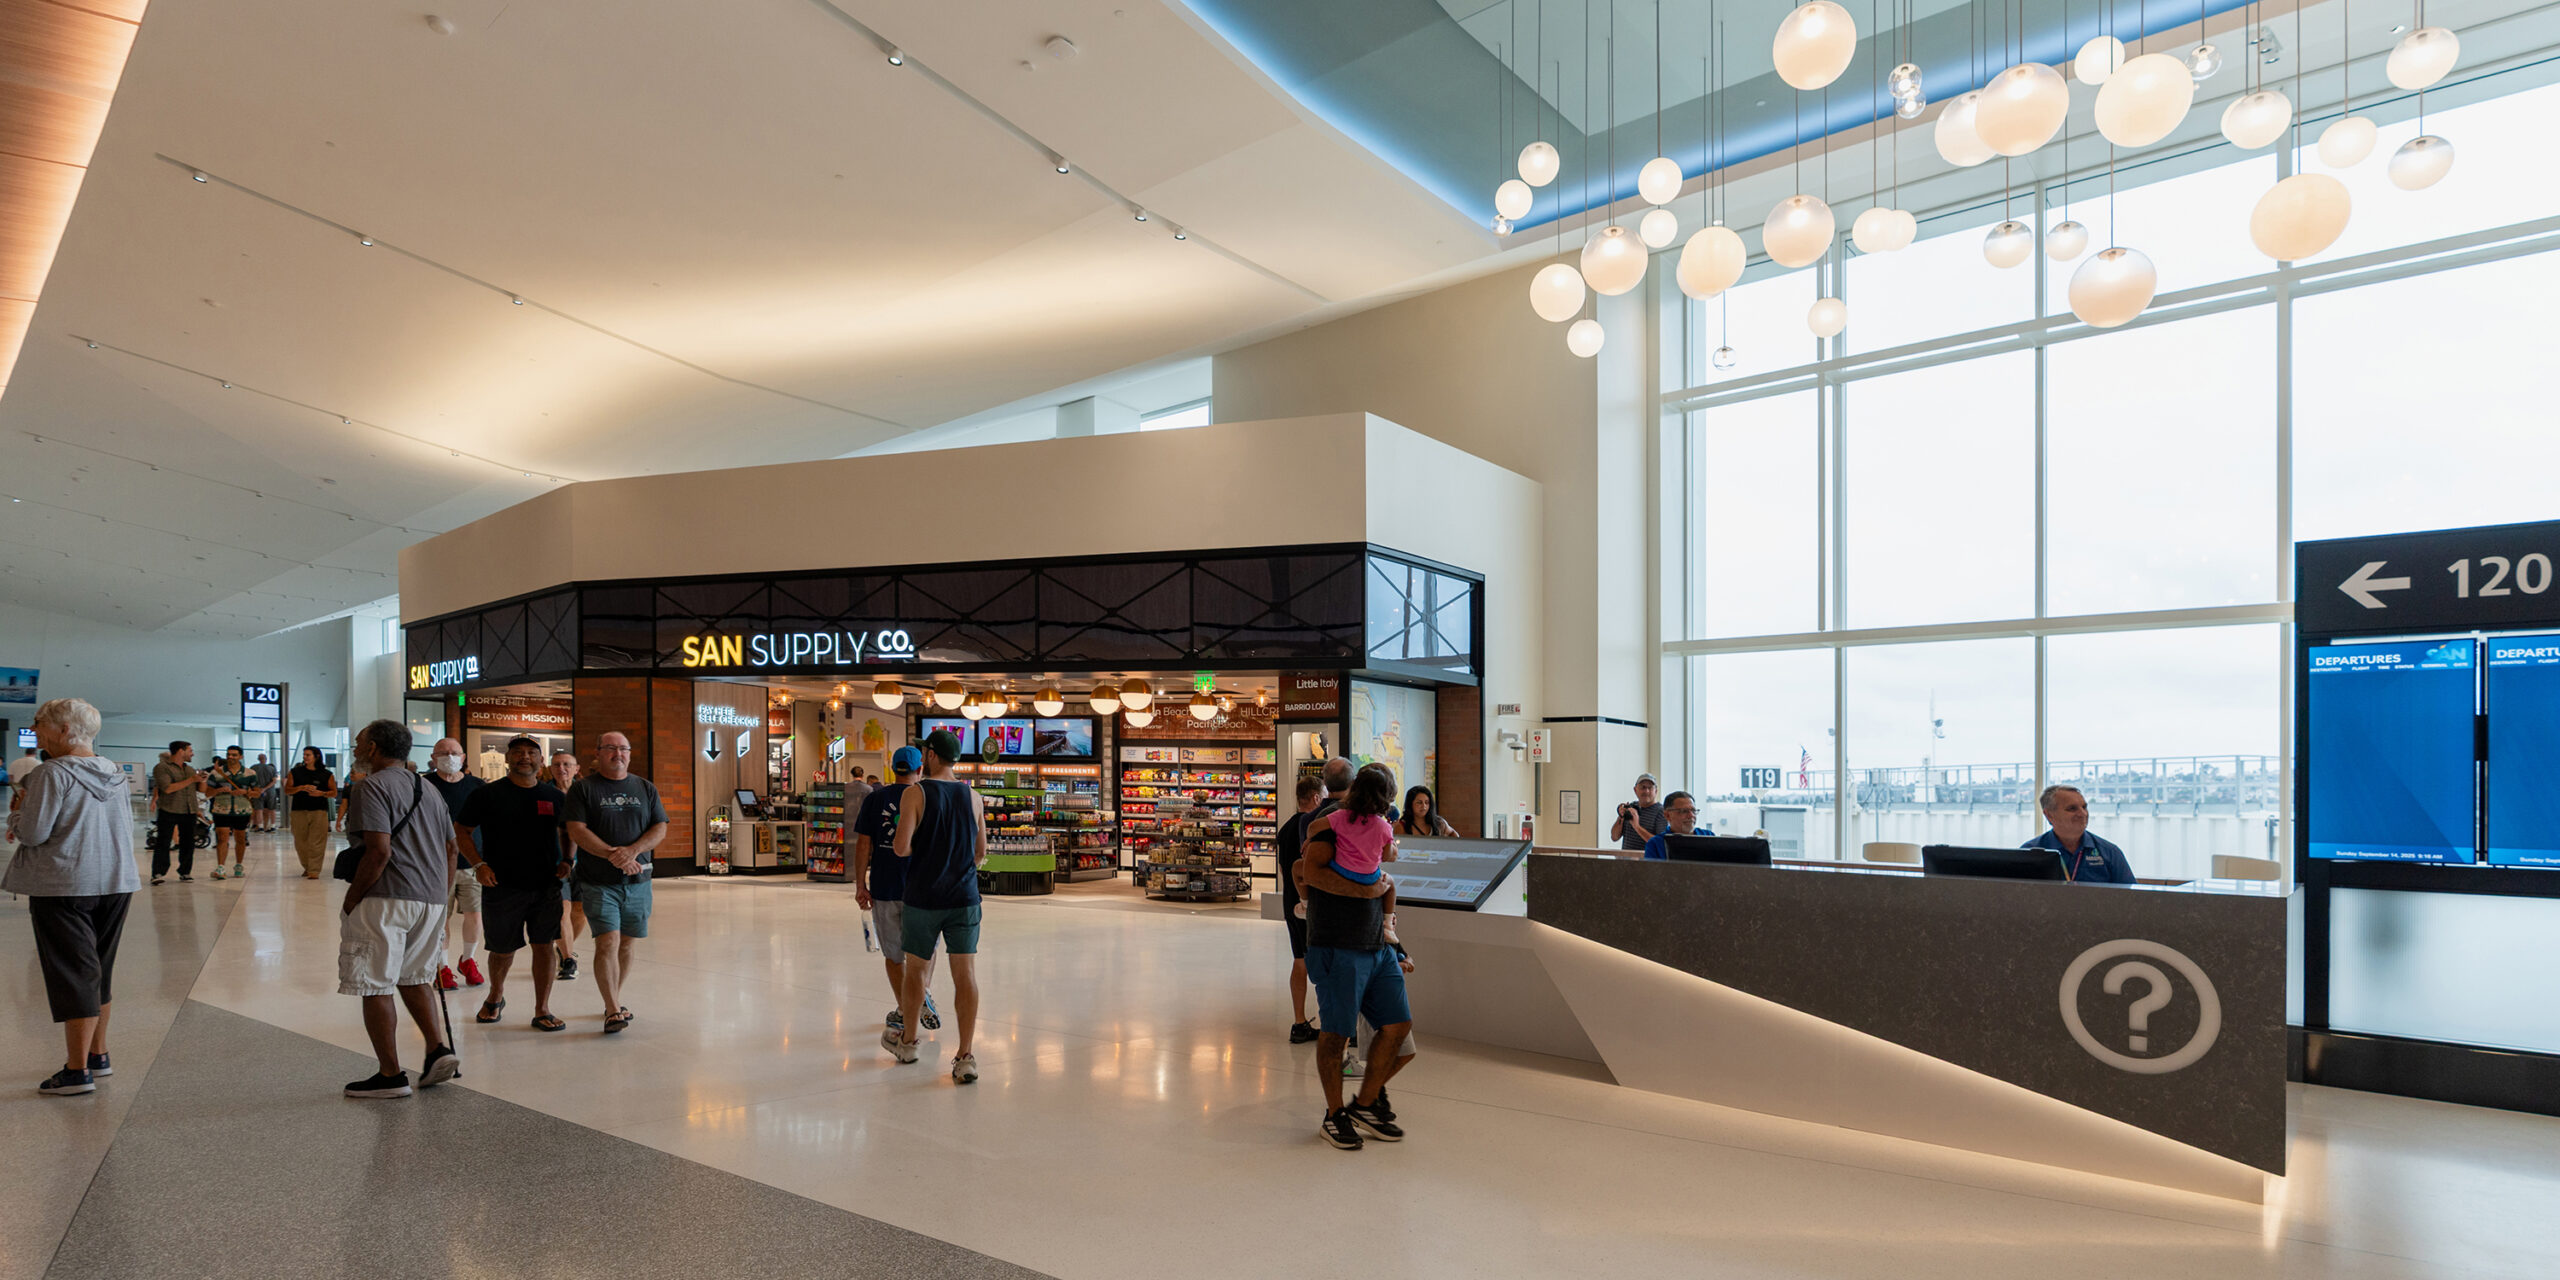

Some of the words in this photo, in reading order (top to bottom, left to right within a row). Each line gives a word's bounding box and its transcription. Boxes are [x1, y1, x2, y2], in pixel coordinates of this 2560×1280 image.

[2447, 553, 2553, 598] 120
[682, 634, 743, 667] SAN
[751, 631, 868, 666] SUPPLY
[877, 630, 914, 652] CO.
[2315, 654, 2401, 666] DEPARTURES
[411, 664, 429, 690] SAN
[430, 658, 465, 687] SUPPLY
[1296, 679, 1319, 689] Little
[1320, 678, 1339, 690] Italy
[245, 686, 279, 701] 120
[470, 696, 507, 706] CORTEZ
[508, 699, 527, 707] HILL
[1285, 703, 1311, 711] BARRIO
[1312, 702, 1336, 711] LOGAN
[1502, 704, 1514, 712] FIRE
[472, 711, 490, 719] OLD
[491, 712, 518, 721] TOWN
[521, 713, 565, 723] MISSION
[1187, 720, 1217, 728] Pacific
[1219, 720, 1247, 728] Beach
[1745, 769, 1775, 788] 119
[600, 796, 640, 805] ALOHA
